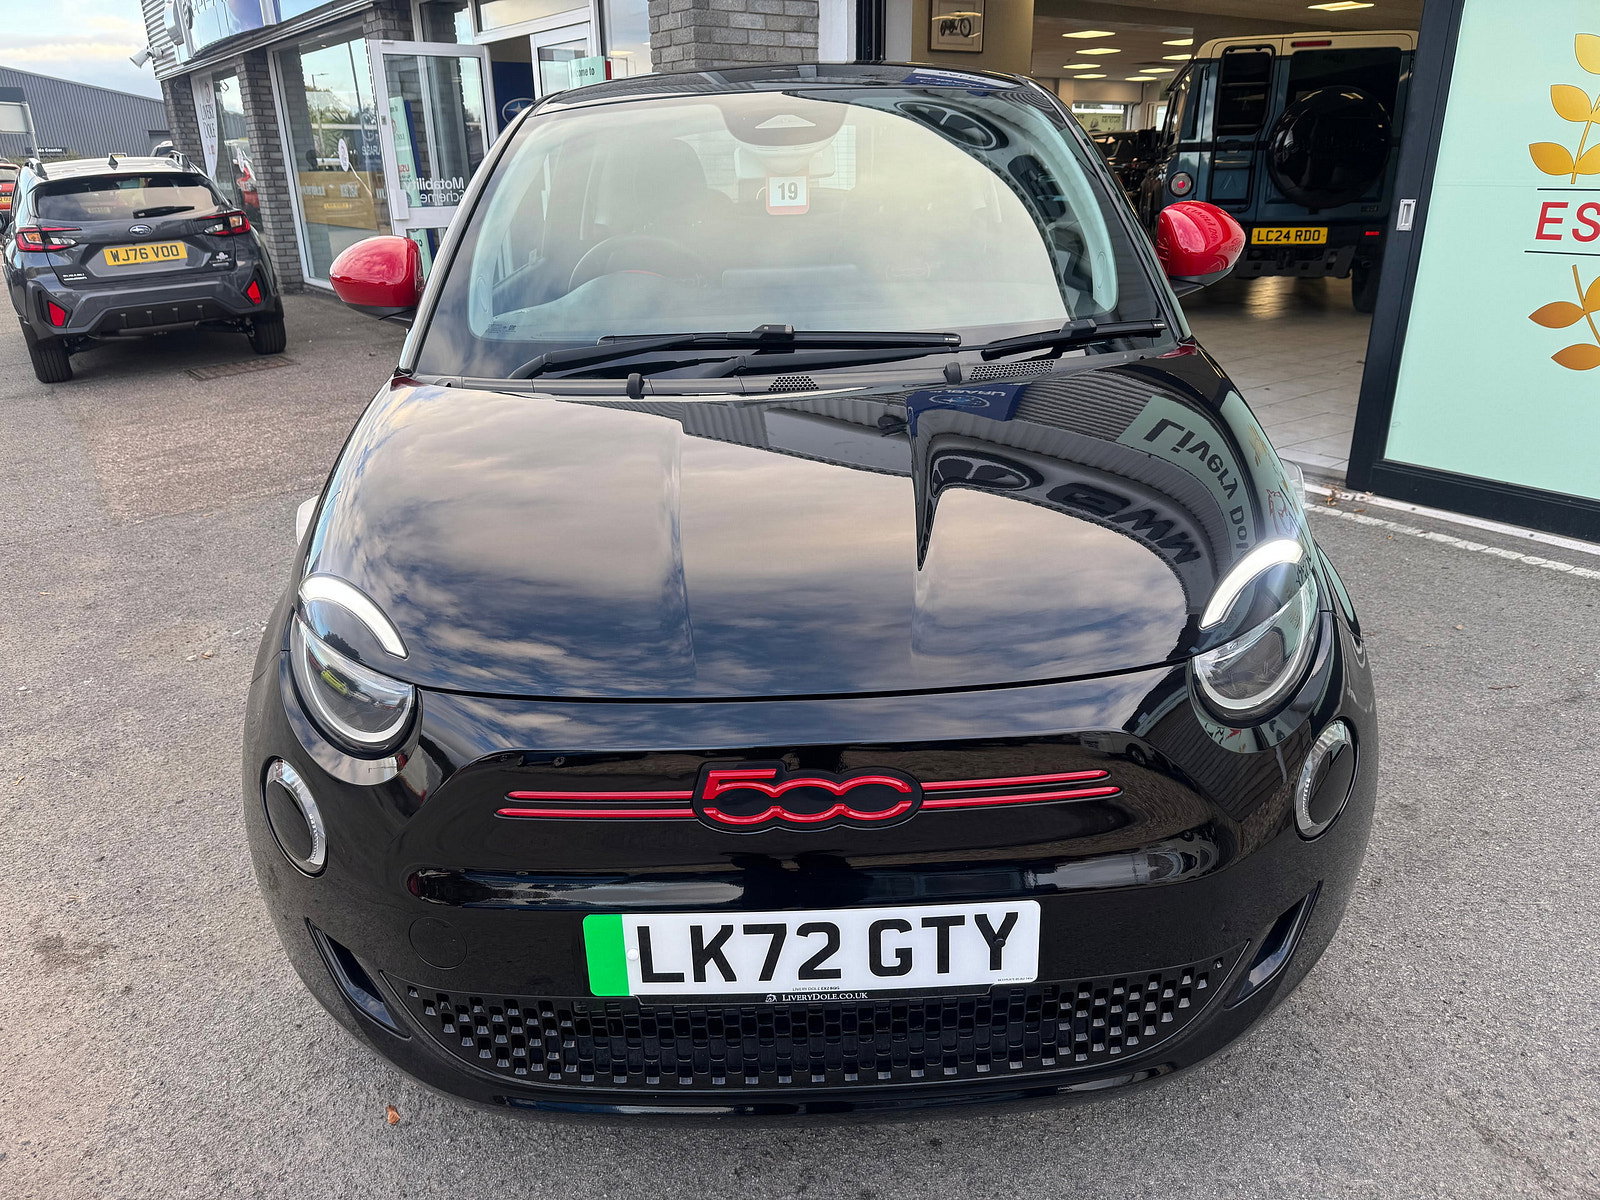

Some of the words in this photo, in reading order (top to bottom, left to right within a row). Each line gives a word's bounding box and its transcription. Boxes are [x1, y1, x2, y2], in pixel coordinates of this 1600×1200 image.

[778, 182, 799, 200] 19
[1257, 230, 1291, 242] LC24
[1295, 230, 1321, 241] RDO
[110, 247, 149, 263] WJ76
[150, 244, 180, 258] VOO
[702, 768, 913, 823] 500
[636, 921, 842, 983] LK72
[868, 912, 1019, 977] GTY
